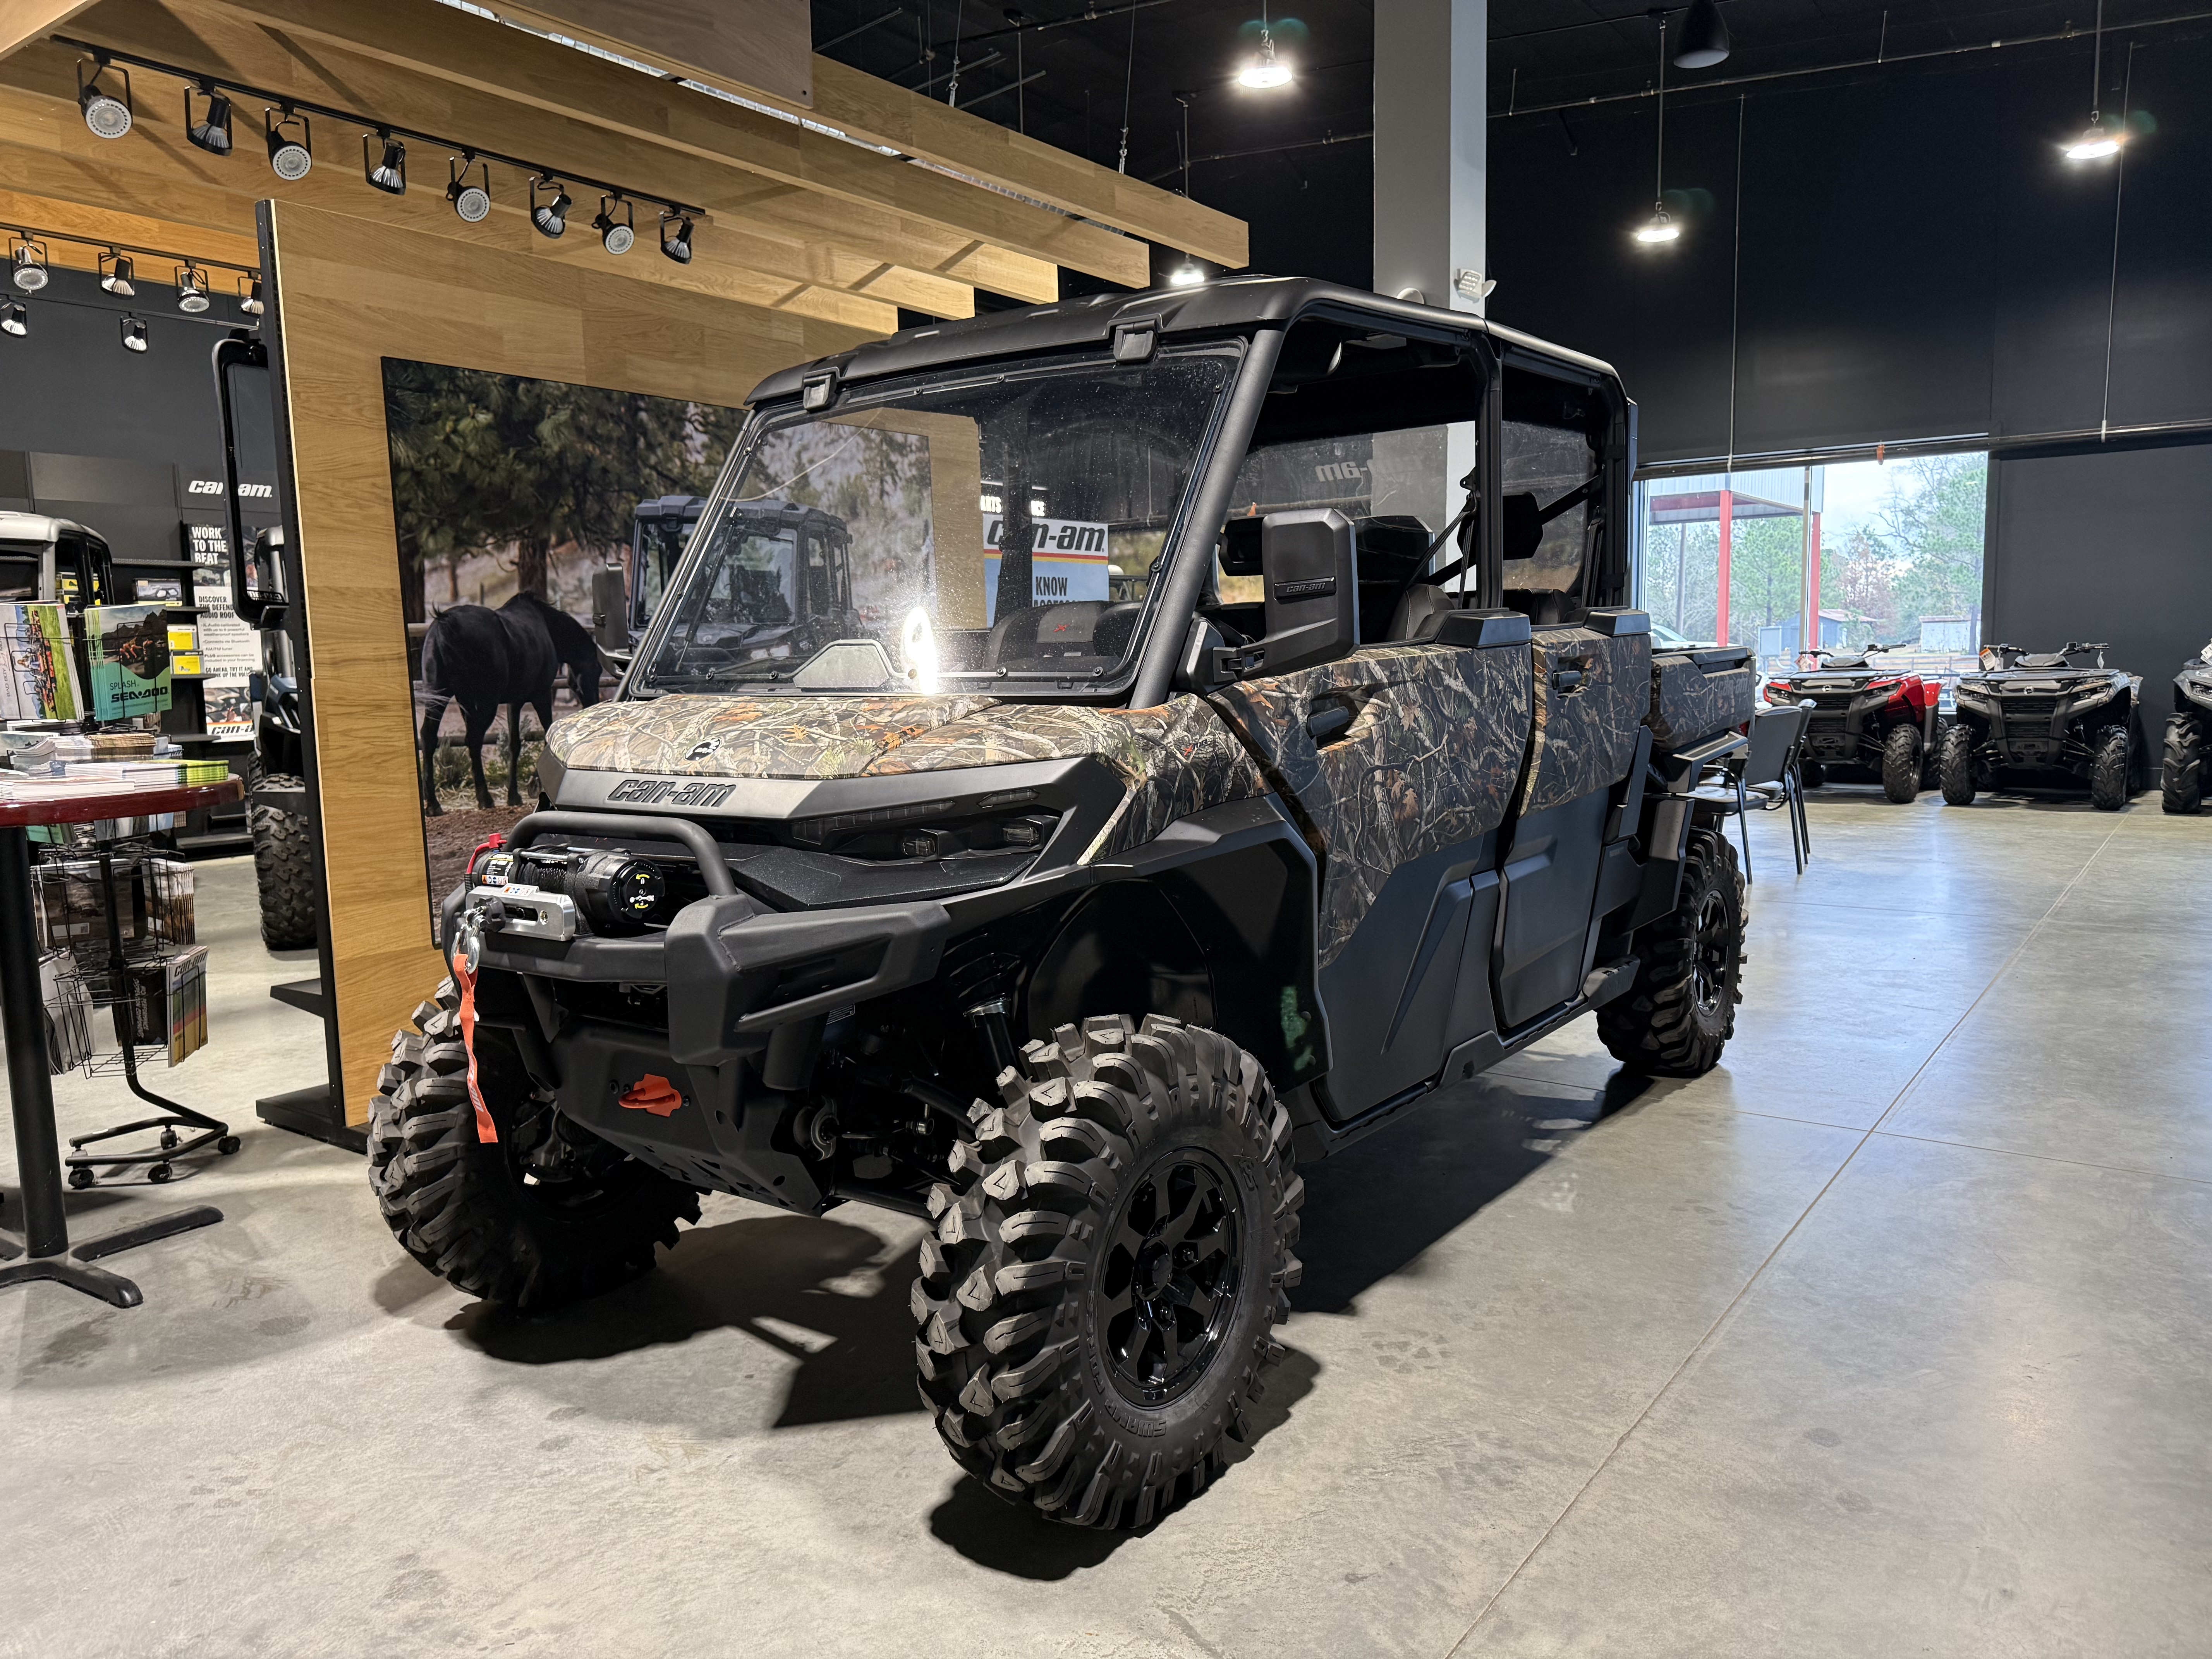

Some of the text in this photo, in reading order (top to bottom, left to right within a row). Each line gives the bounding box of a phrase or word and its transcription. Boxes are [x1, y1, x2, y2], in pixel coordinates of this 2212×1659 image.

[981, 495, 1002, 513] ARTS
[192, 527, 222, 539] WORK
[987, 520, 1105, 552] cn-am
[192, 539, 228, 552] TO THE
[194, 553, 219, 565] BEAT
[1036, 576, 1068, 596] KNOW
[1286, 582, 1326, 592] can-am
[110, 680, 136, 690] SPLASH
[211, 725, 253, 734] can-a
[607, 779, 737, 807] can-am
[174, 951, 208, 977] can-am
[1104, 1398, 1166, 1437] SWAMP
